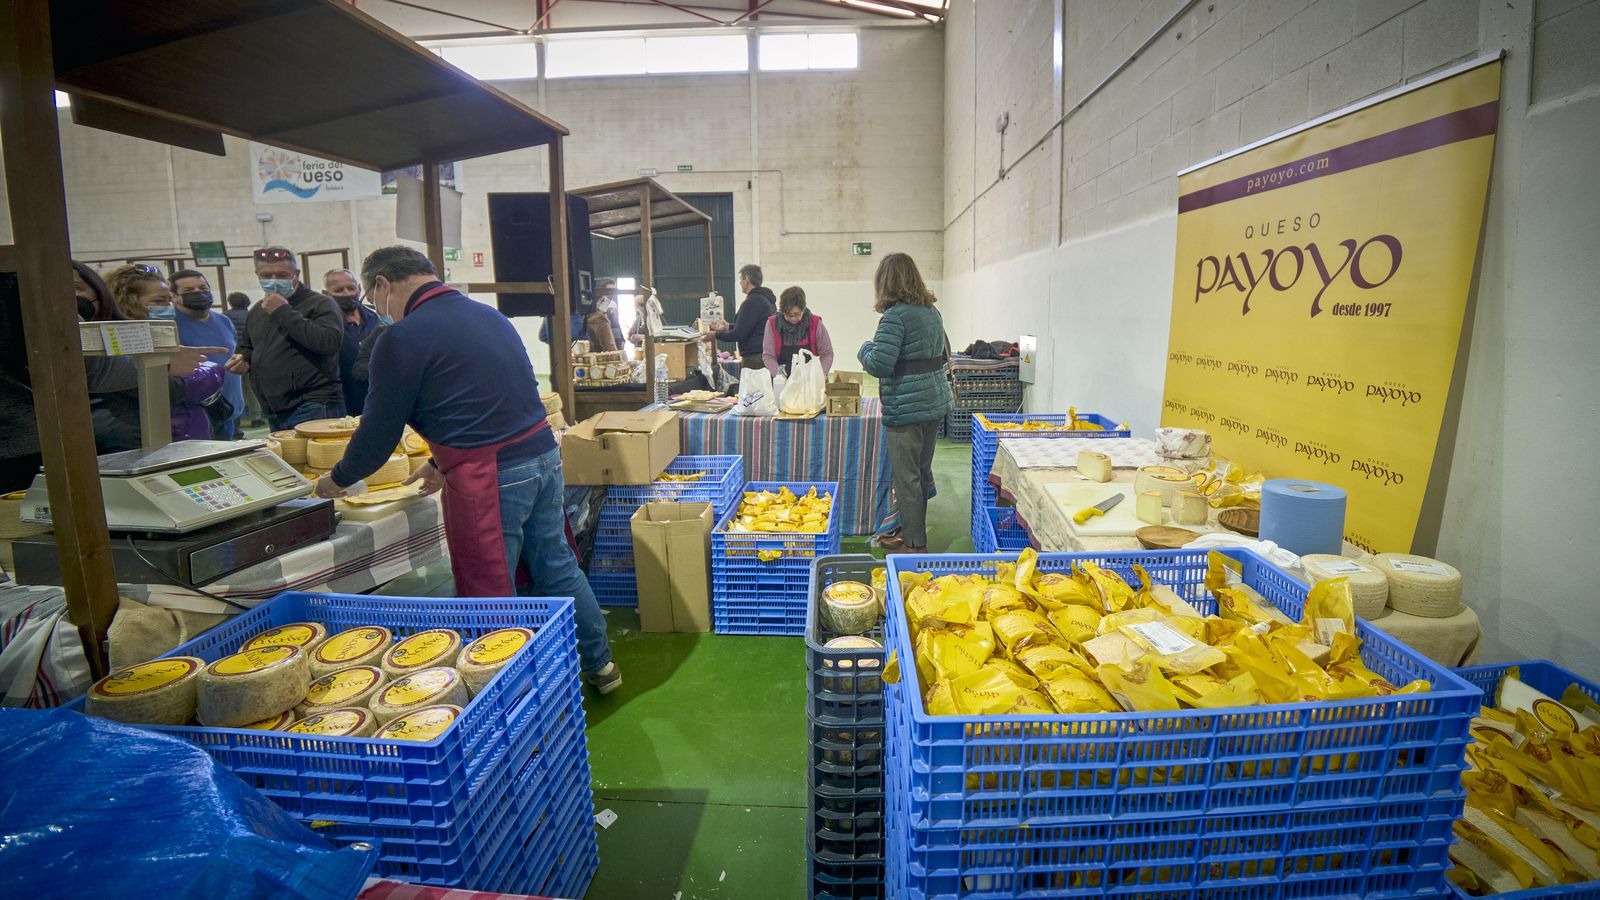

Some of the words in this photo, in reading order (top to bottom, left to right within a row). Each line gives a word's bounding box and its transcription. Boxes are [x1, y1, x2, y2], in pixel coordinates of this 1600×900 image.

[303, 160, 325, 170] feria
[303, 170, 344, 183] ueso
[1247, 157, 1329, 192] payoyo.com
[1245, 212, 1321, 239] QUESO
[1332, 302, 1361, 317] desde
[1363, 302, 1392, 317] 1997
